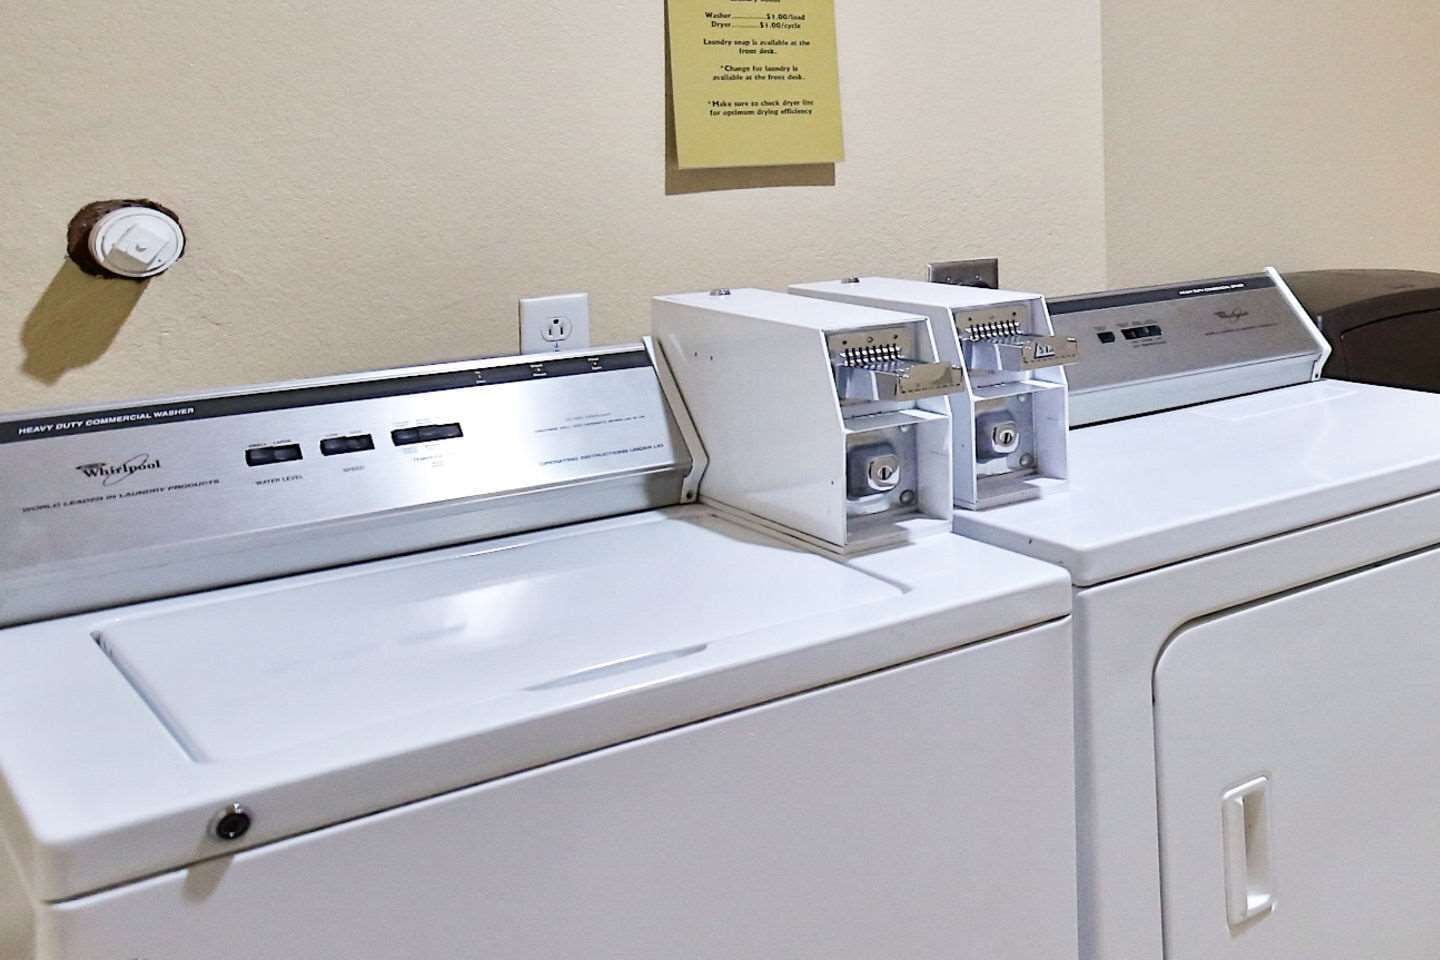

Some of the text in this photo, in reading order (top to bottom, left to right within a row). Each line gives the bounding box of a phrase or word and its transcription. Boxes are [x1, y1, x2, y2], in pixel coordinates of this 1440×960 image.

[703, 38, 732, 46] Laundry
[760, 99, 780, 107] check
[782, 99, 800, 107] dryer
[722, 109, 755, 117] optimum
[757, 108, 779, 116] drying
[18, 407, 195, 436] HEAVY DUTY COMMERCIAL WASHER
[77, 457, 162, 481] Whirlpool
[255, 474, 304, 486] WATER LEVEL
[22, 501, 62, 513] WORLD
[63, 495, 104, 507] LEADER
[119, 486, 166, 499] LAUNDRY
[167, 478, 220, 491] PRODUCTS
